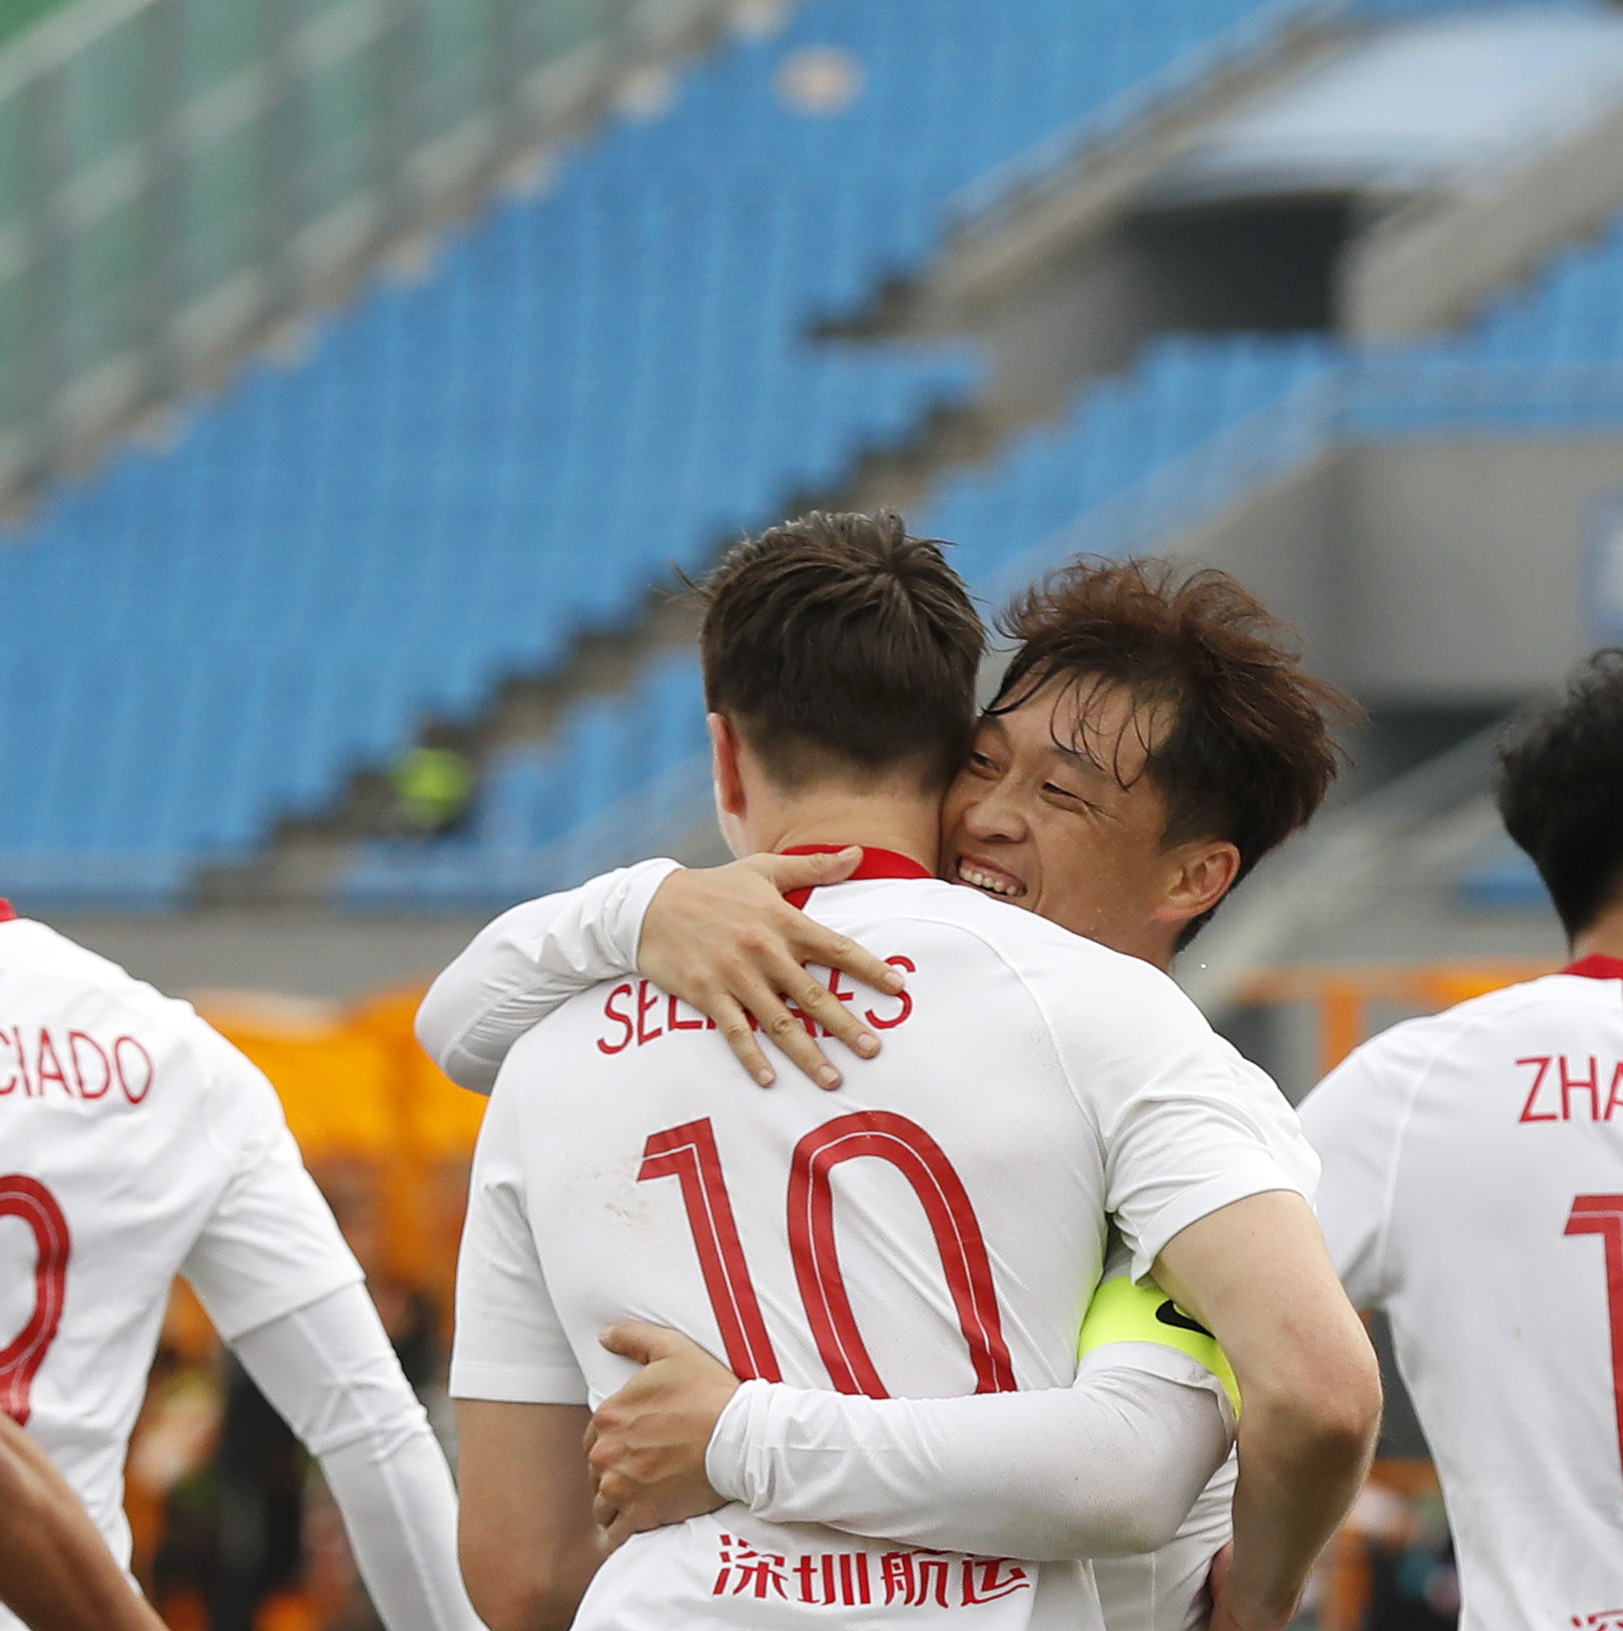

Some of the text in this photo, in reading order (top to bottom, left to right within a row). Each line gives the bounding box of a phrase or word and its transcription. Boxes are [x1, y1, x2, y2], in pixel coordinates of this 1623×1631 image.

[637, 1109, 1018, 1400] 10
[712, 1534, 1030, 1609] 深圳航运
